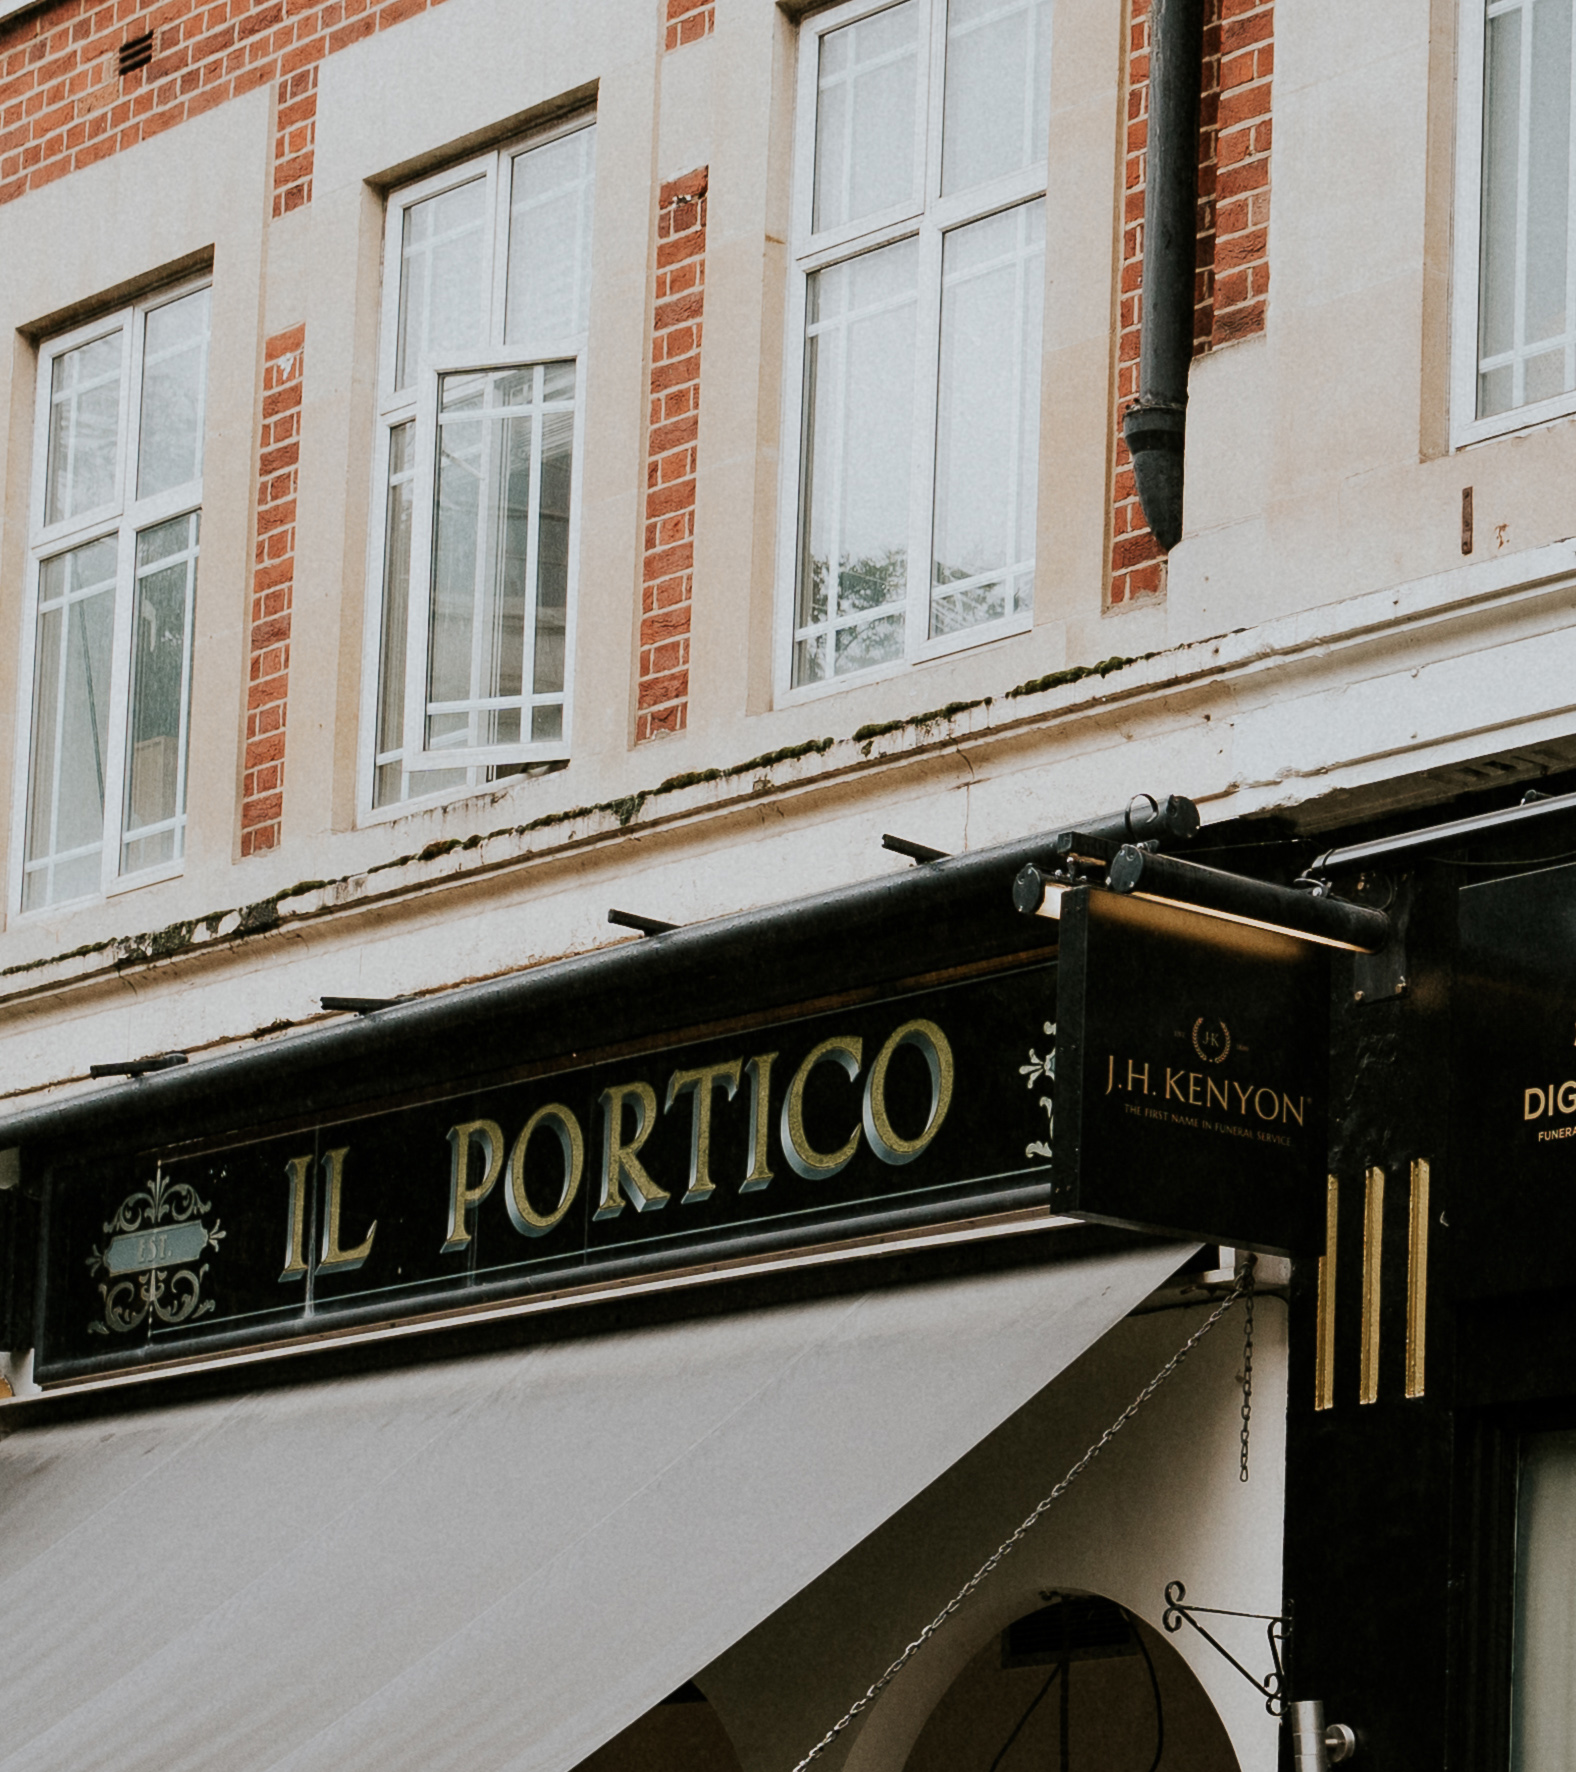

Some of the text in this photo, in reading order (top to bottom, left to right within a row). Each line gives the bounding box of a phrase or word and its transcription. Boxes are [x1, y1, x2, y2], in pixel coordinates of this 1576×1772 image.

[1105, 1055, 1307, 1128] J.H. KENYON
[1124, 1103, 1254, 1139] THE FIRST NAME FUNERAL
[279, 1017, 956, 1283] IL PORTICO
